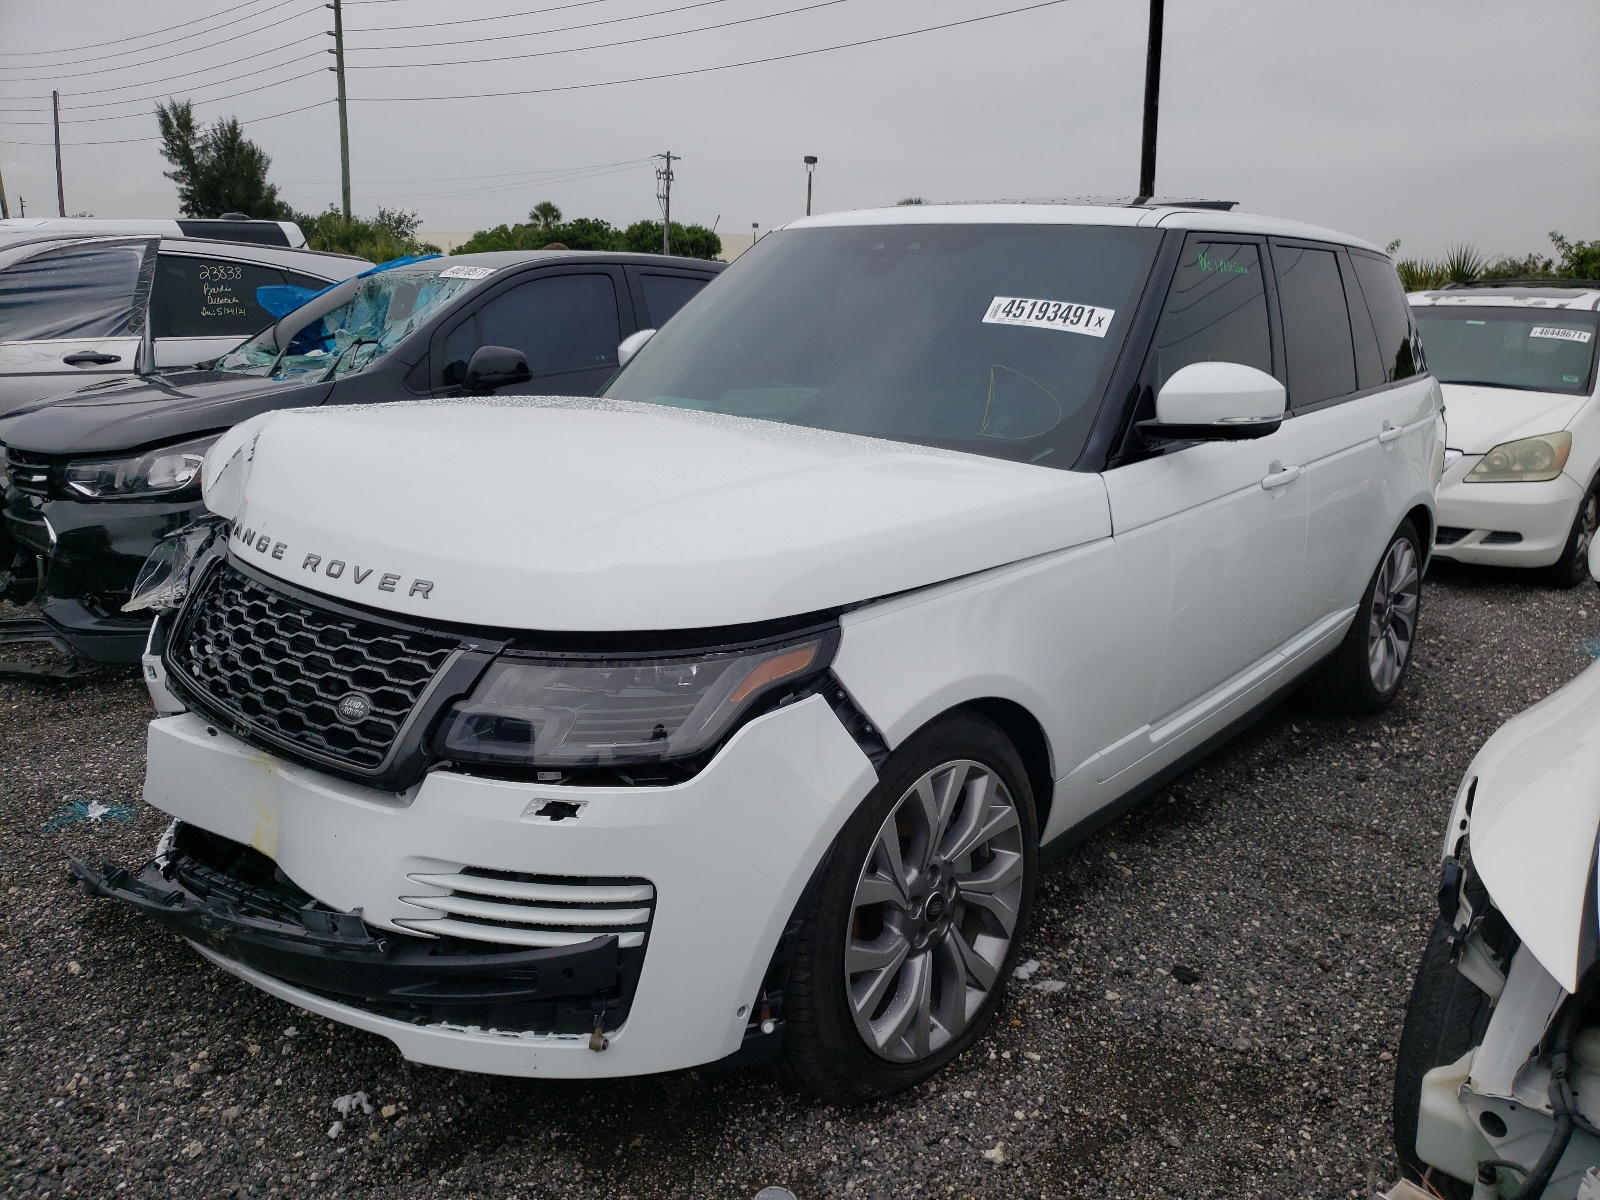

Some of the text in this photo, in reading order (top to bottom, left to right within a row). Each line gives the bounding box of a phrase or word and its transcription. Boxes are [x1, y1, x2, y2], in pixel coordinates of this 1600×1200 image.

[199, 264, 242, 281] 23838
[1001, 299, 1096, 328] 45193491
[301, 553, 434, 599] ROVER
[342, 706, 364, 718] ROVER
[344, 698, 362, 709] LAND
